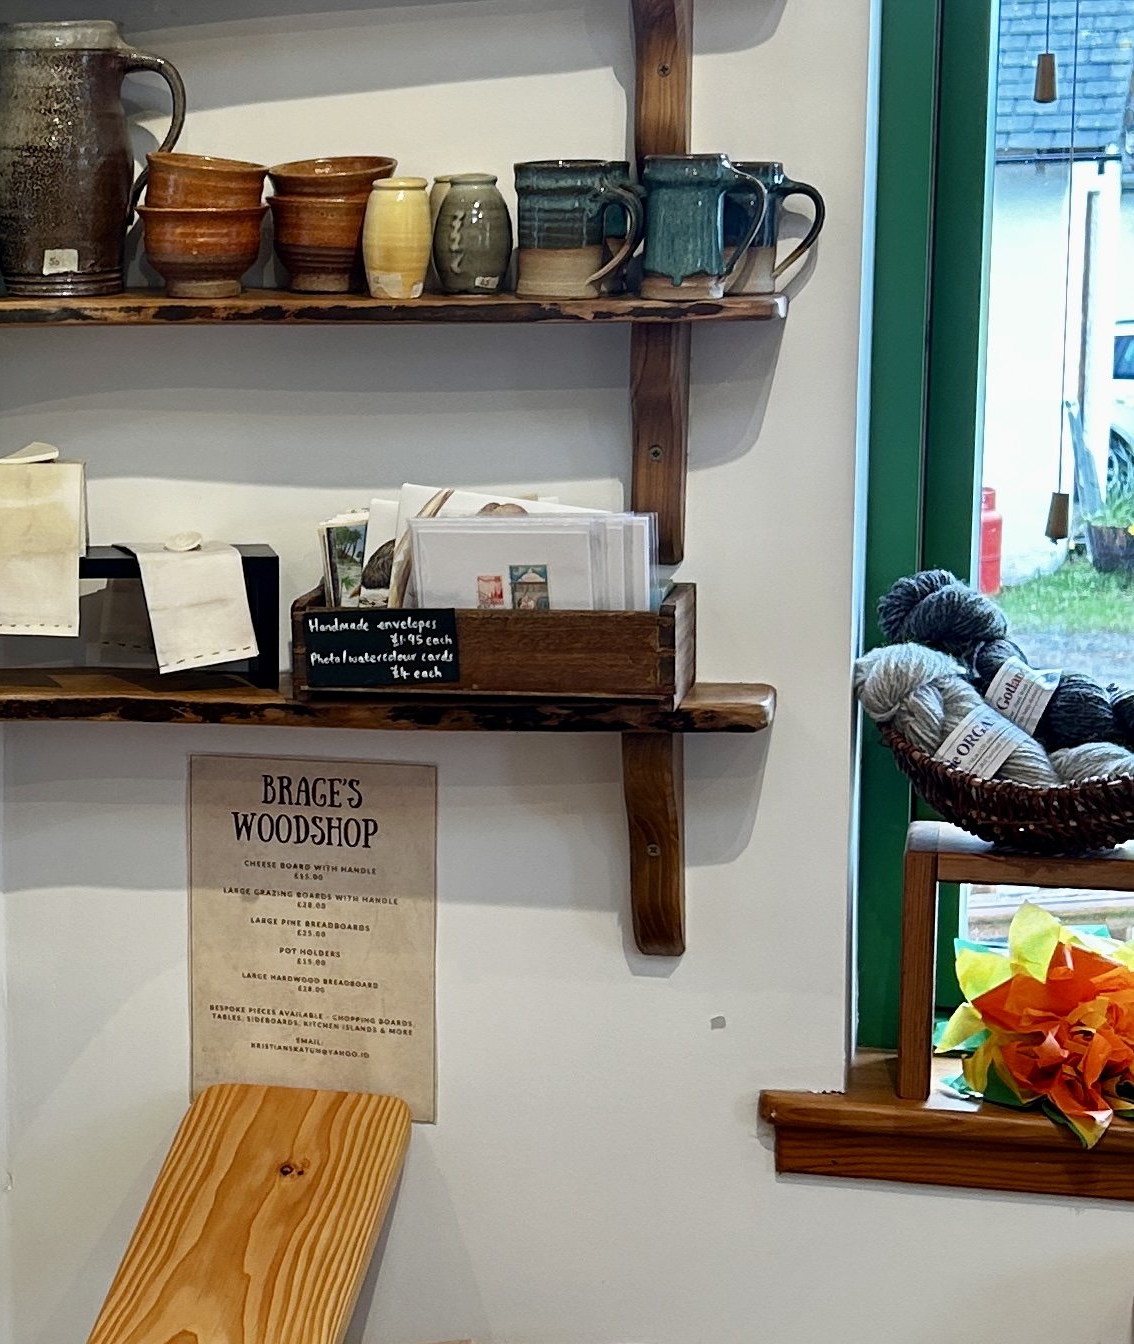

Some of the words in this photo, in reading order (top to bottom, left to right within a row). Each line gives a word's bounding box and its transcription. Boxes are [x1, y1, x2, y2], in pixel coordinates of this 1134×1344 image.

[309, 618, 369, 632] Handmade
[377, 617, 436, 633] envelopes
[426, 634, 452, 645] each
[421, 650, 453, 662] cards
[390, 665, 410, 679] £4
[414, 666, 442, 678] each
[261, 774, 362, 809] BRAGE'S
[231, 811, 379, 848] WOODSHOP
[244, 860, 276, 868] CHEESE
[280, 862, 311, 870] BOARD
[314, 864, 338, 872] WITH
[341, 866, 376, 875] HANDLE
[223, 887, 250, 895] LARGE
[254, 889, 293, 898] GRAZING
[296, 891, 332, 900] BOARDS
[335, 894, 359, 902] WITH
[362, 897, 398, 905] HANDLE
[250, 917, 277, 925] LARGE
[281, 918, 301, 927] PINE
[305, 920, 370, 932] BREADBOARDS
[279, 947, 297, 955] POT
[300, 948, 340, 958] HOLDERS
[242, 972, 267, 981] LARGE
[270, 975, 320, 984] HARDWOOD
[323, 978, 378, 989] BREADBOARD
[209, 1004, 245, 1013] BESPOKE
[248, 1007, 276, 1015] PIECES
[279, 1010, 323, 1020] AVAILABLE
[332, 1015, 375, 1024] CHOPPING
[303, 1020, 339, 1030] KITCHEN
[342, 1024, 377, 1033] ISLANDS
[388, 1028, 412, 1036] MORE
